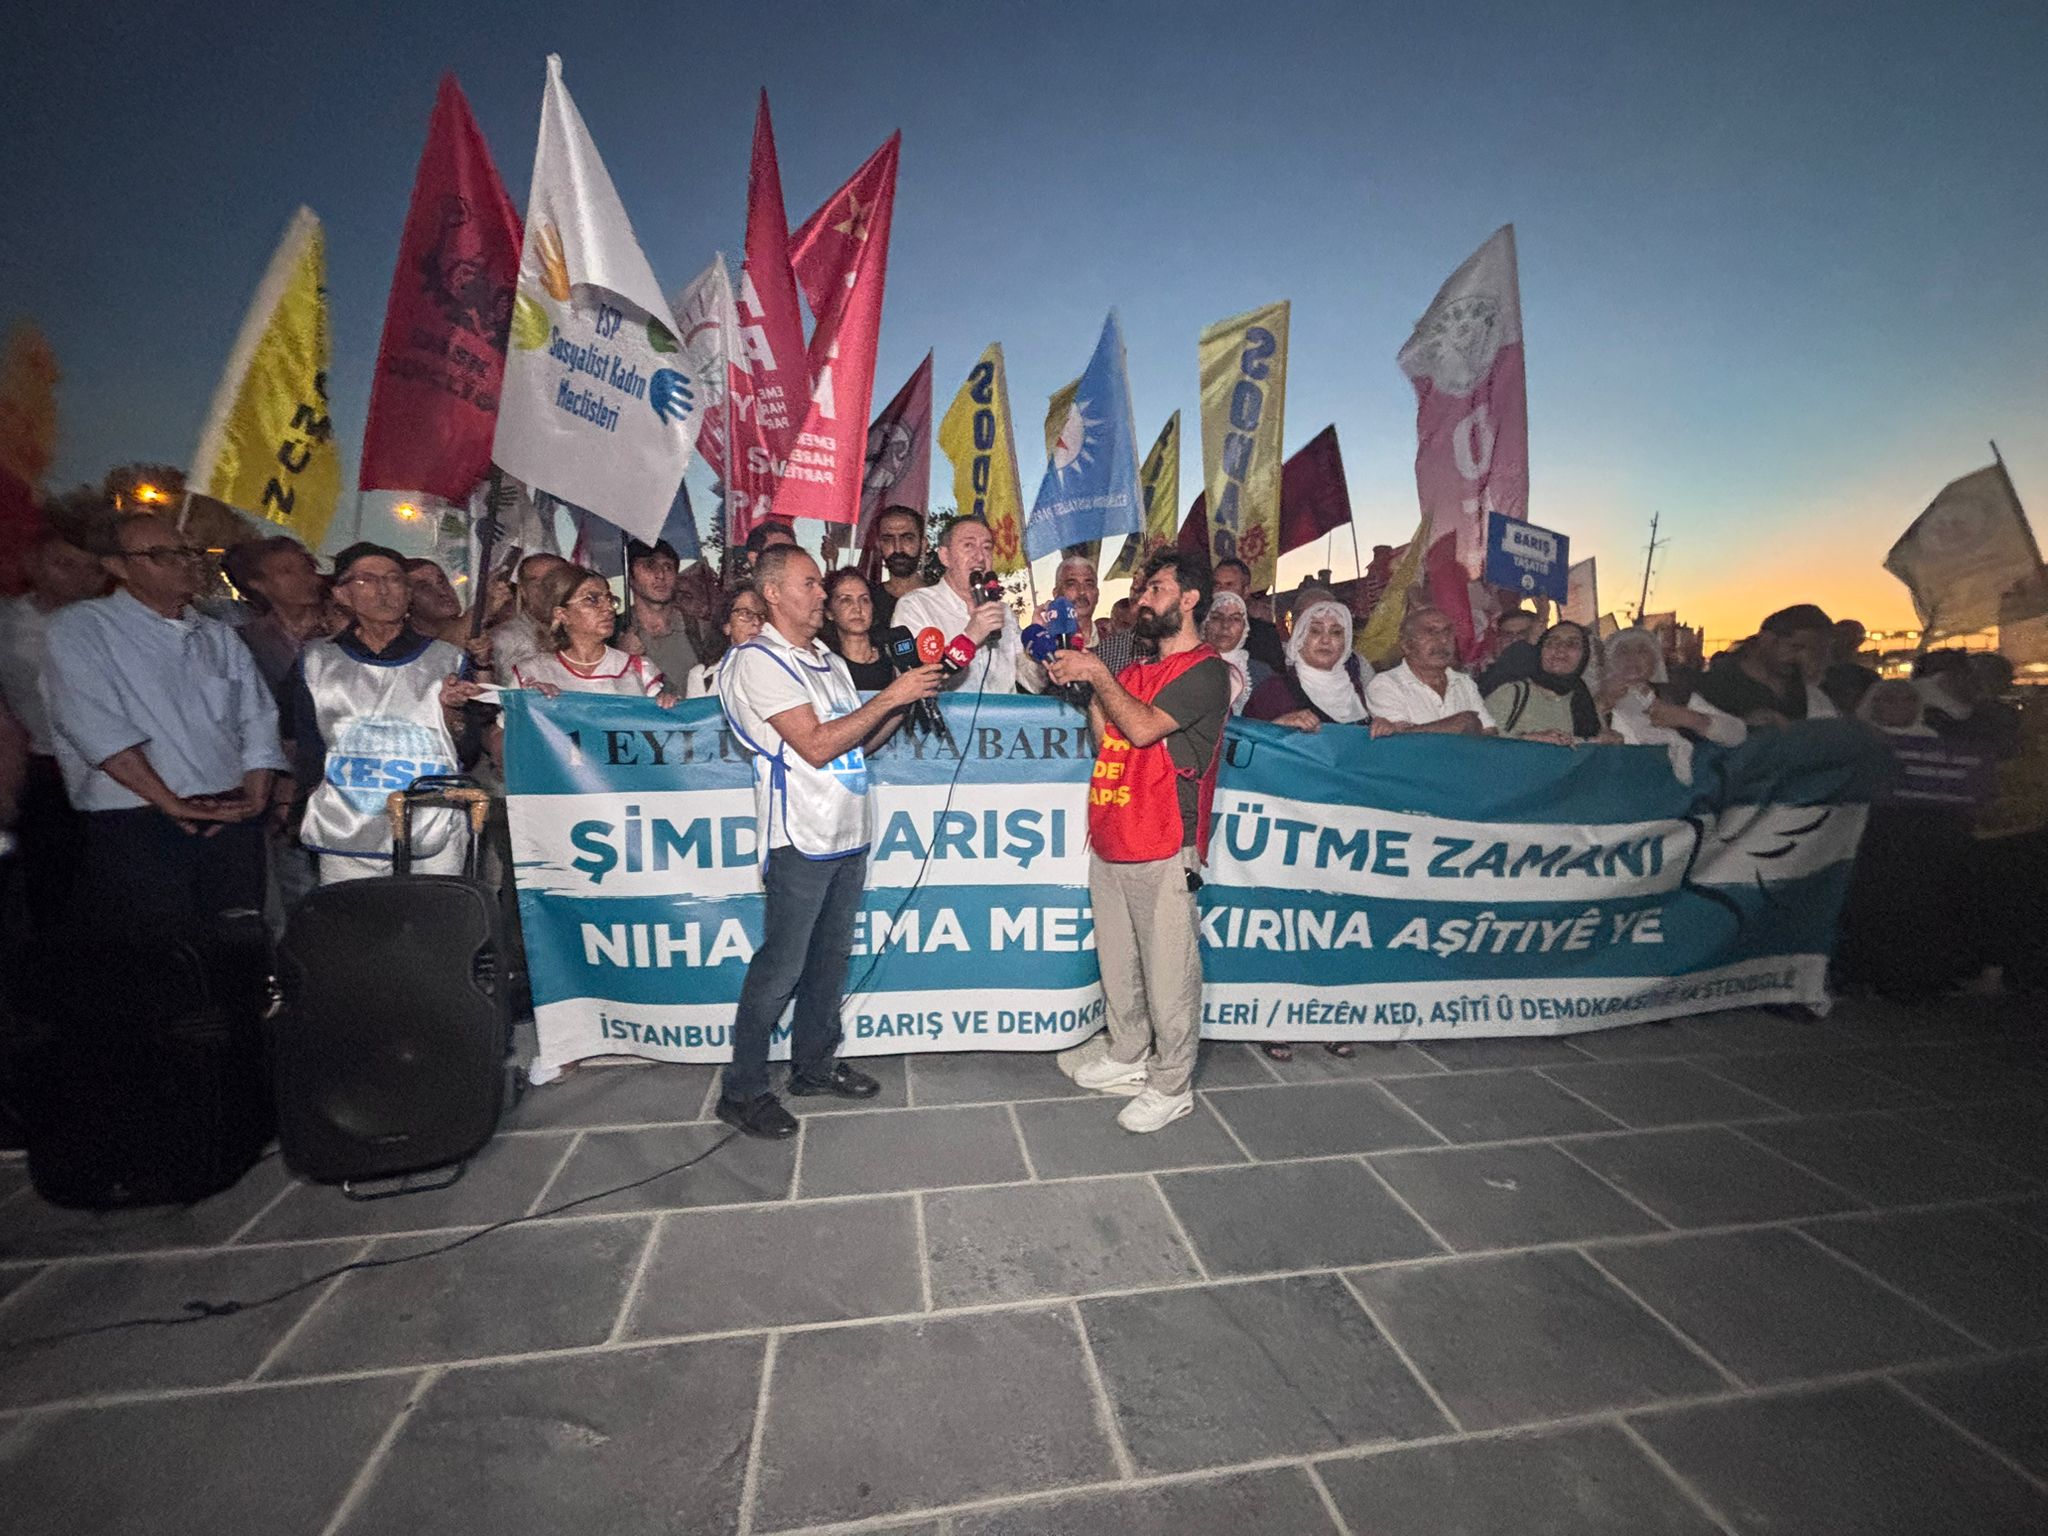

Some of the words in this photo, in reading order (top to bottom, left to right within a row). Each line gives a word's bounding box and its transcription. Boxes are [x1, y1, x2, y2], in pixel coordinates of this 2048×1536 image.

[595, 303, 625, 342] ESP
[1513, 531, 1551, 556] BARIŞ
[975, 726, 1090, 761] BARI
[569, 804, 760, 885] ŞİMD
[873, 809, 1066, 870] ARIŞI
[1211, 802, 1412, 878] ÜTME
[1427, 834, 1666, 879] ZAMANI
[580, 918, 754, 969] NIHA
[1608, 906, 1665, 946] YE
[856, 1010, 943, 1040] BARIŞ
[951, 1010, 989, 1035] VE
[996, 999, 1105, 1036] DEMOKR
[1202, 998, 1260, 1025] LERİ
[1287, 999, 1368, 1026] HÊZÊN
[1373, 1001, 1424, 1028] KED,
[1430, 993, 1491, 1029] AŞÎTÎ
[1497, 994, 1515, 1022] Û
